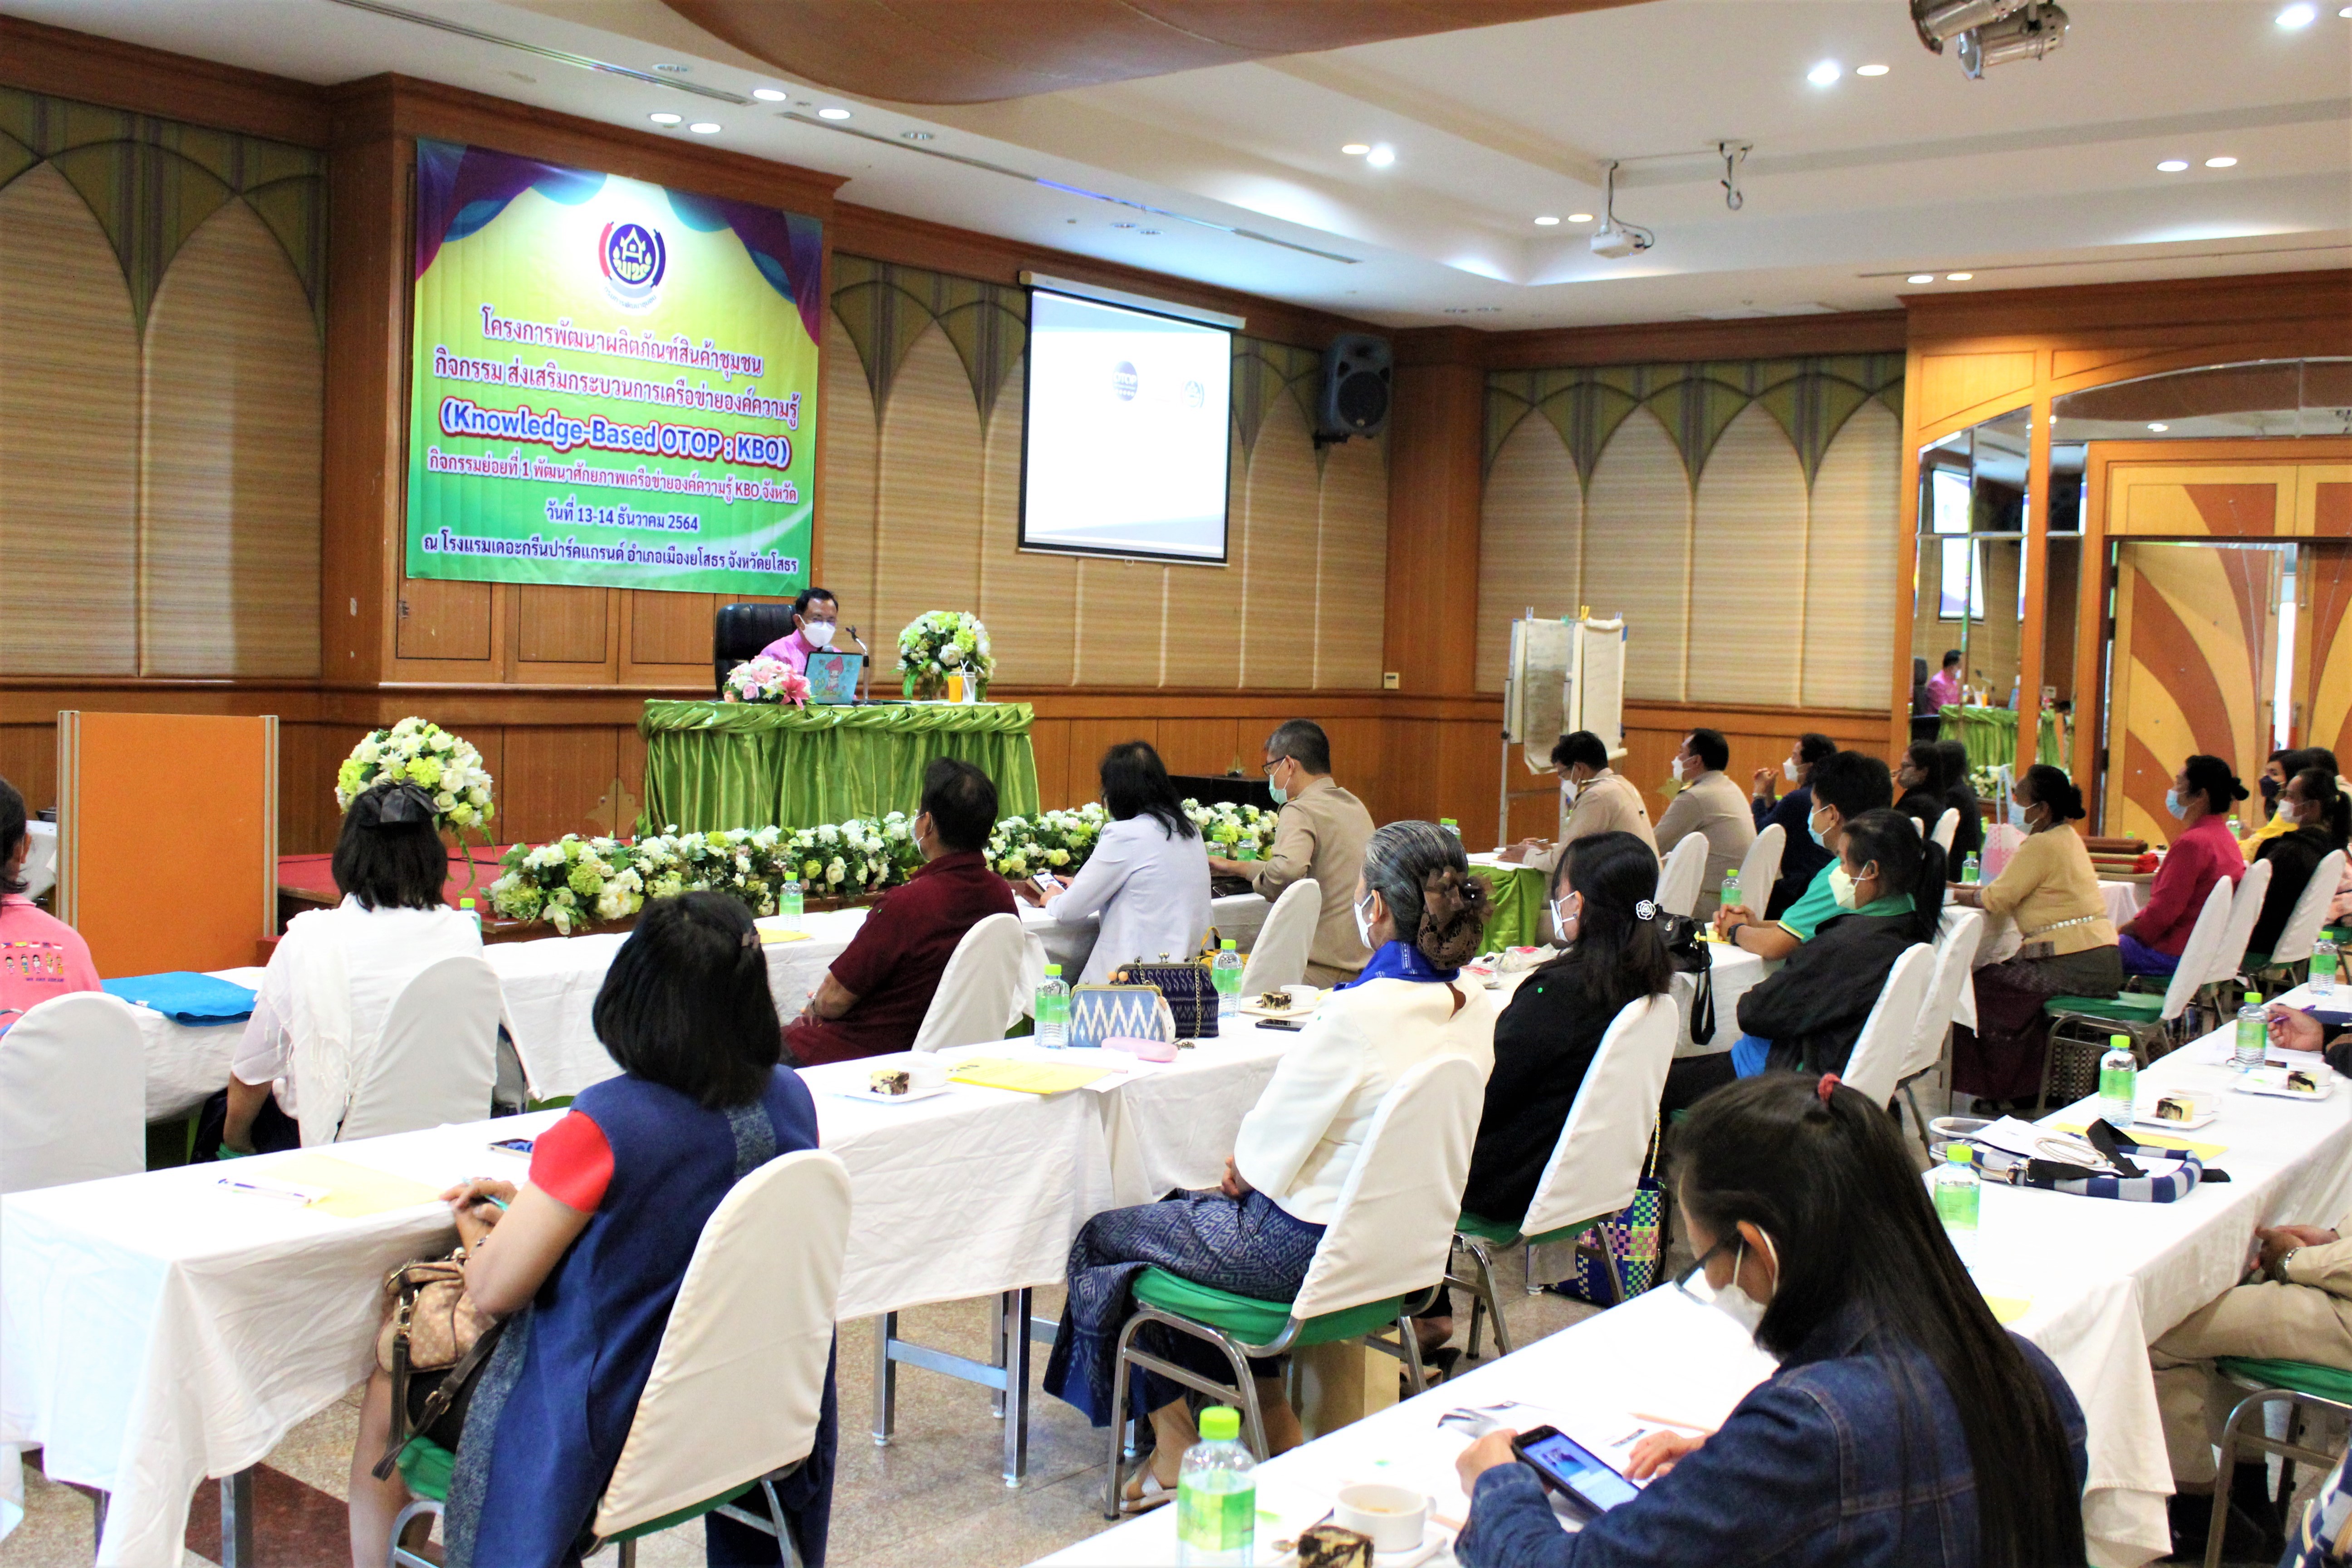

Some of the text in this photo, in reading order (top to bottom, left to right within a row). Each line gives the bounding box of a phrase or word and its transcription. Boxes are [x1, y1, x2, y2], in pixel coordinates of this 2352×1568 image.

[482, 305, 761, 379] โครงการพัฒนาผลิตภัณฑ์สินค้าชุมชน
[435, 347, 799, 427] กิจกรรม ส่งเสริมกระบวนการเครือข่ายองค์ความรู้
[1113, 372, 1137, 385] OTOP
[444, 402, 656, 448] (Knowledge-Based
[662, 428, 720, 455] OTOP
[738, 436, 787, 464] KBO)
[430, 448, 797, 501] กิจกรรมย่อยที่ 1 พัฒนาศักยภาพเครือข่ายองค์ความรู้ KBO จังหวัด
[547, 496, 698, 530] วันที่ 13-14 ธันวาคม 2564
[425, 529, 798, 572] ณ โรงแรมเดอะกรีนปาร์คแกรนด์ อำเภอเมืองยโสธร จังหวัดยโสธร
